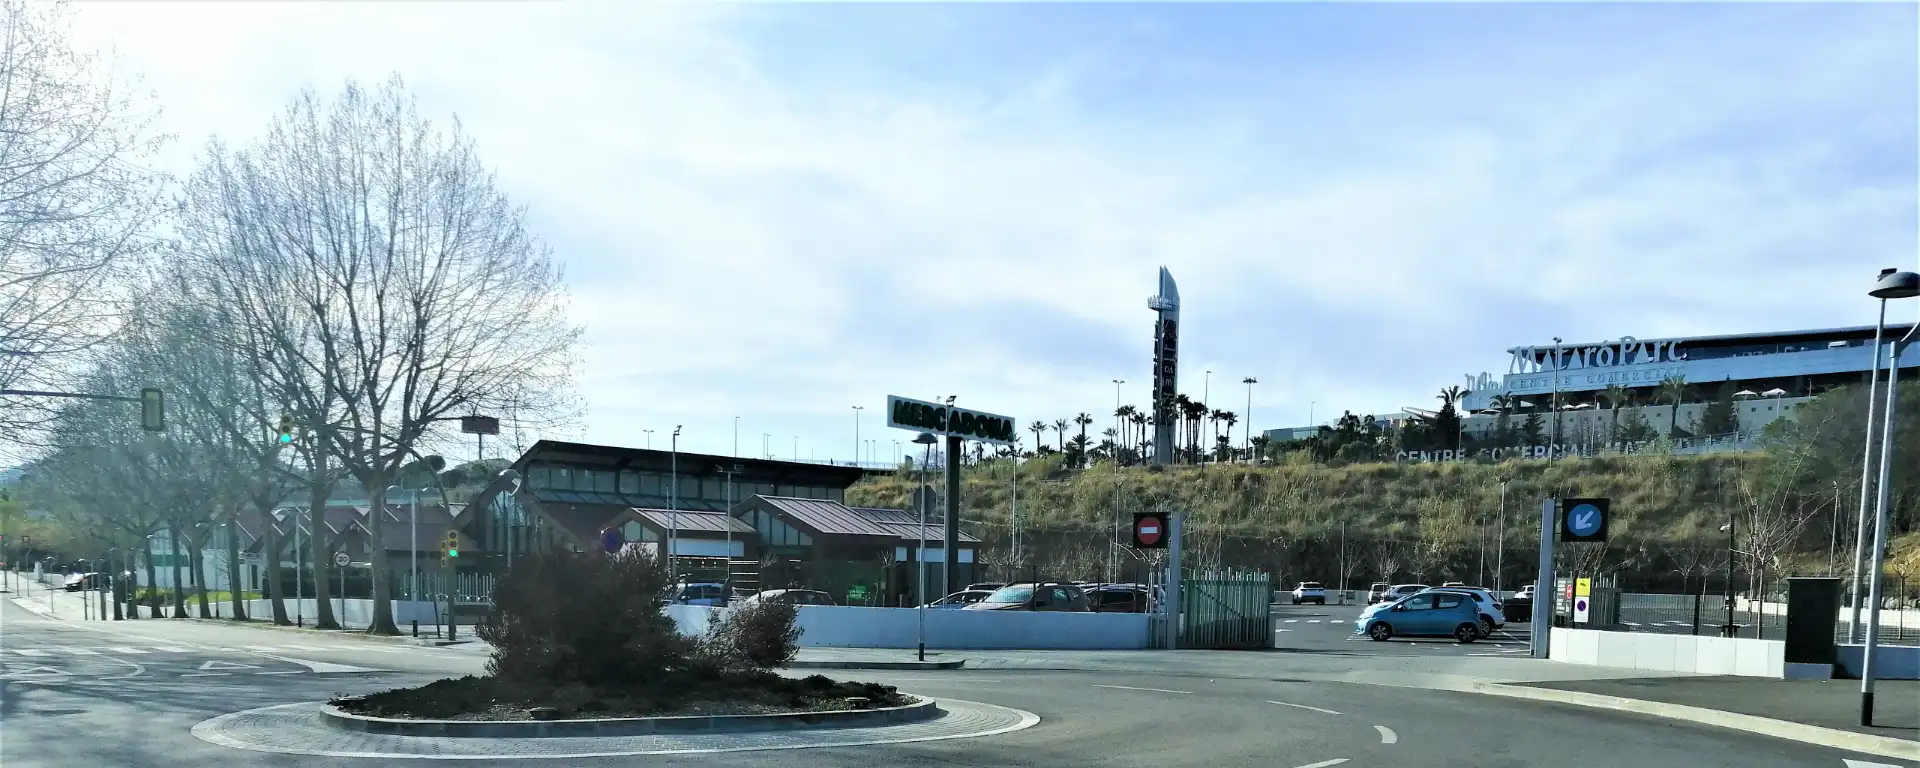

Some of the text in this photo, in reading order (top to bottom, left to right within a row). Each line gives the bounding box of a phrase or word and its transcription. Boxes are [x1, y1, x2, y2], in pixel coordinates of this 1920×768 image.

[1507, 376, 1572, 390] CENTE
[893, 399, 1015, 442] MERCADONA
[1396, 448, 1465, 464] CENTRE
